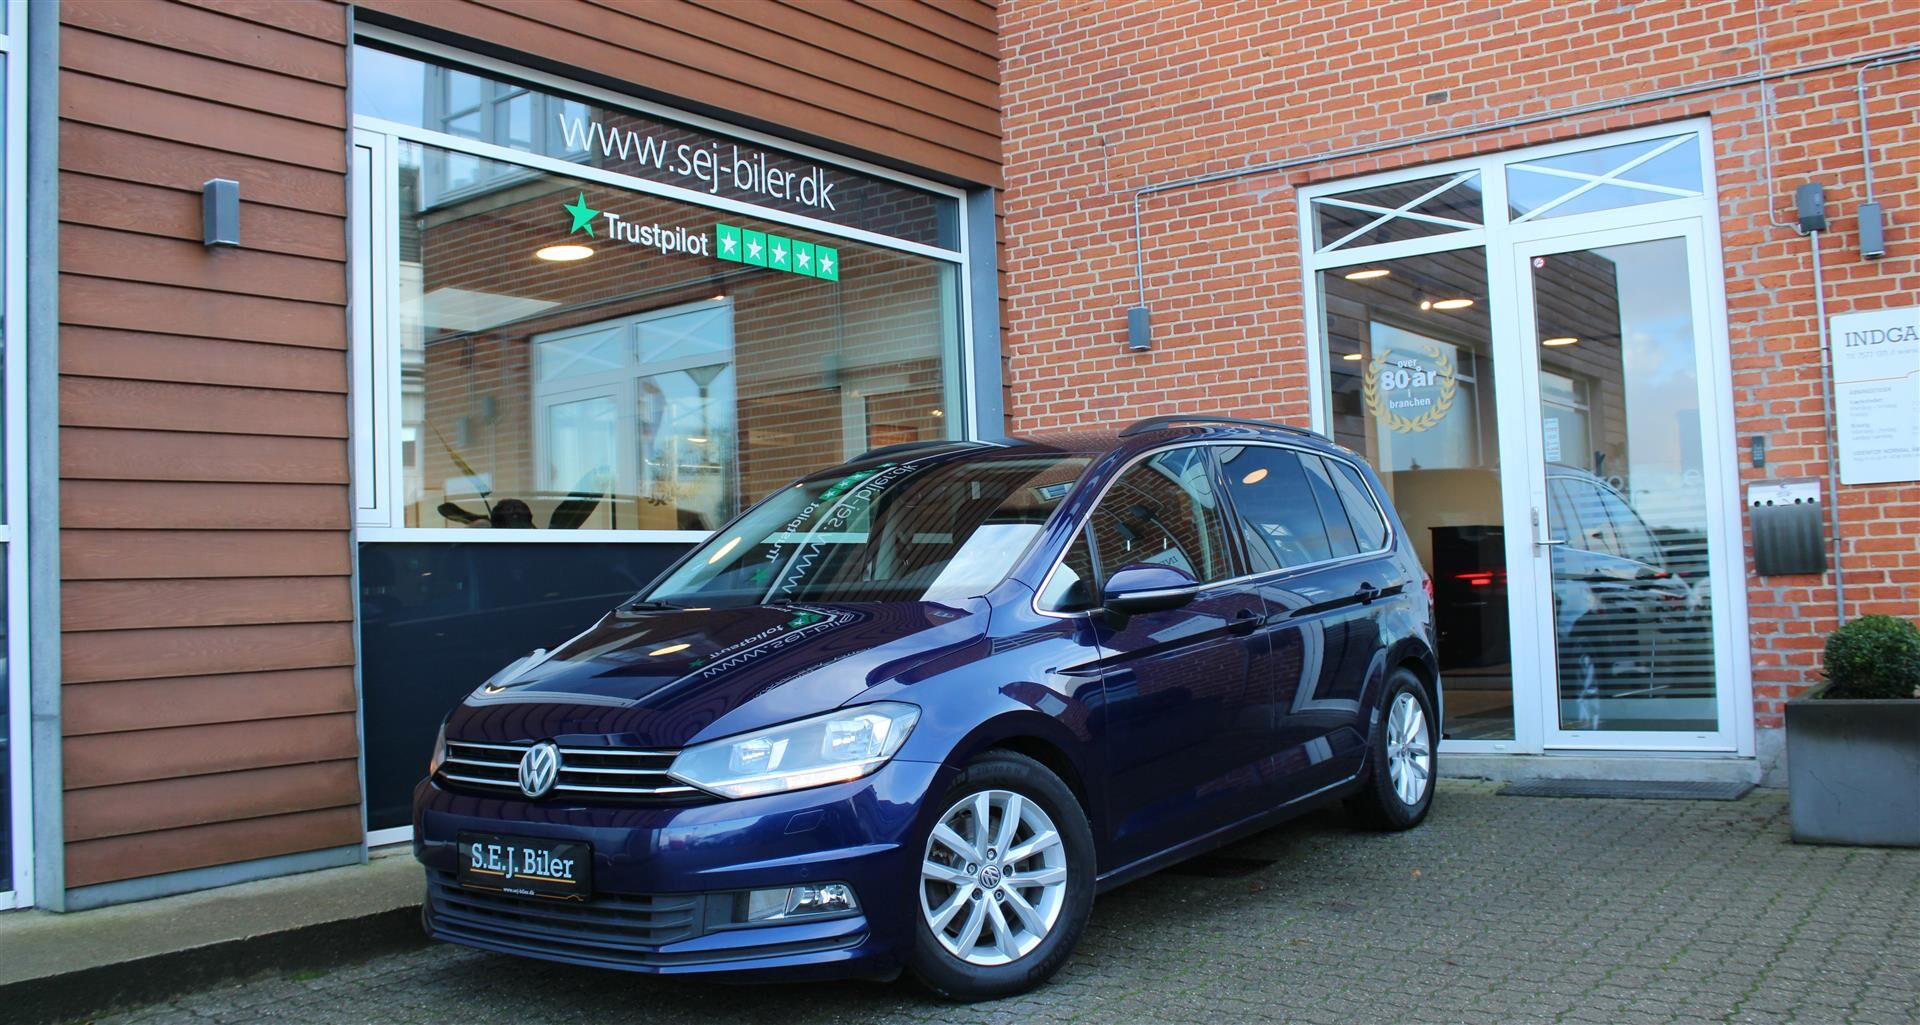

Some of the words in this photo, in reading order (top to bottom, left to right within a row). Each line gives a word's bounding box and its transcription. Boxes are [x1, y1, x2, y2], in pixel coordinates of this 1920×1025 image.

[560, 113, 836, 211] www.sej-biler.dk
[603, 212, 709, 256] Trustpilot
[1380, 369, 1409, 390] 80
[1412, 365, 1437, 387] år
[1397, 359, 1417, 368] over
[1389, 398, 1431, 409] branchen
[471, 842, 519, 879] S.E.J.
[523, 848, 574, 879] Biler
